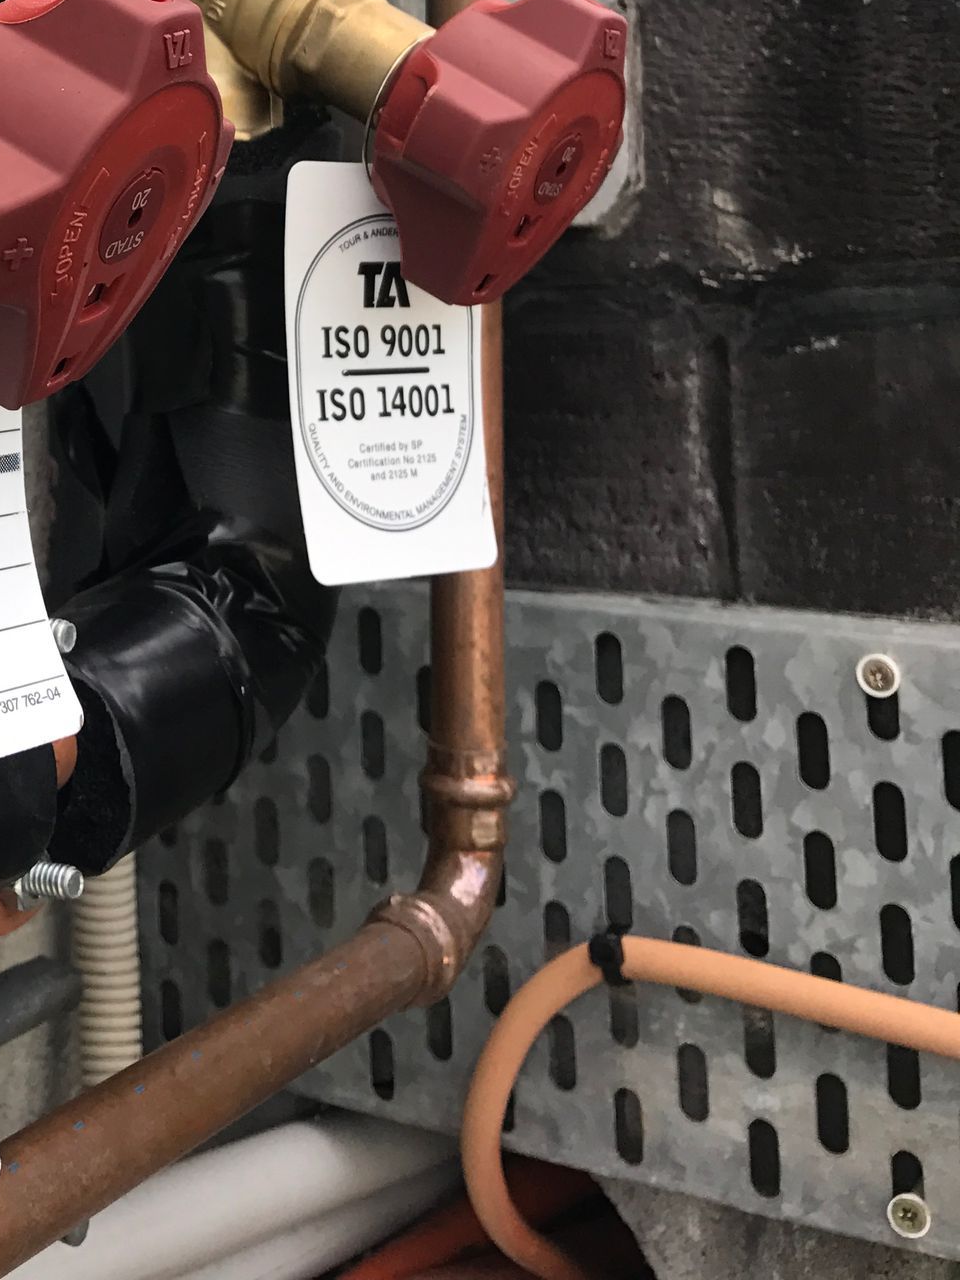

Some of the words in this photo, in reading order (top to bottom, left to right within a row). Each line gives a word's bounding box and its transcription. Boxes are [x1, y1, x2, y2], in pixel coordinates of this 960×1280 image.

[509, 140, 539, 189] OPEN
[131, 187, 152, 211] 20
[55, 211, 88, 275] OPEN
[105, 231, 144, 259] STAD
[338, 233, 361, 254] TOUR
[363, 231, 370, 240] &
[357, 261, 411, 308] TA
[321, 324, 370, 359] ISO
[380, 323, 446, 357] 9001
[316, 387, 366, 422] ISO
[377, 384, 456, 419] 14001
[347, 455, 401, 469] Certification
[403, 455, 415, 465] No
[416, 452, 437, 465] 2125
[359, 441, 396, 454] Certified
[398, 441, 408, 453] by
[308, 422, 331, 470] QUALITY
[327, 471, 345, 494] AND
[343, 489, 415, 521] ENVIRONMENTAL
[415, 459, 458, 514] MANAGEMENT
[455, 414, 468, 459] SYSTEM
[370, 471, 386, 481] and
[388, 468, 408, 480] 2125
[410, 467, 419, 478] M
[0, 697, 20, 715] 307
[21, 686, 62, 709] 762-04
